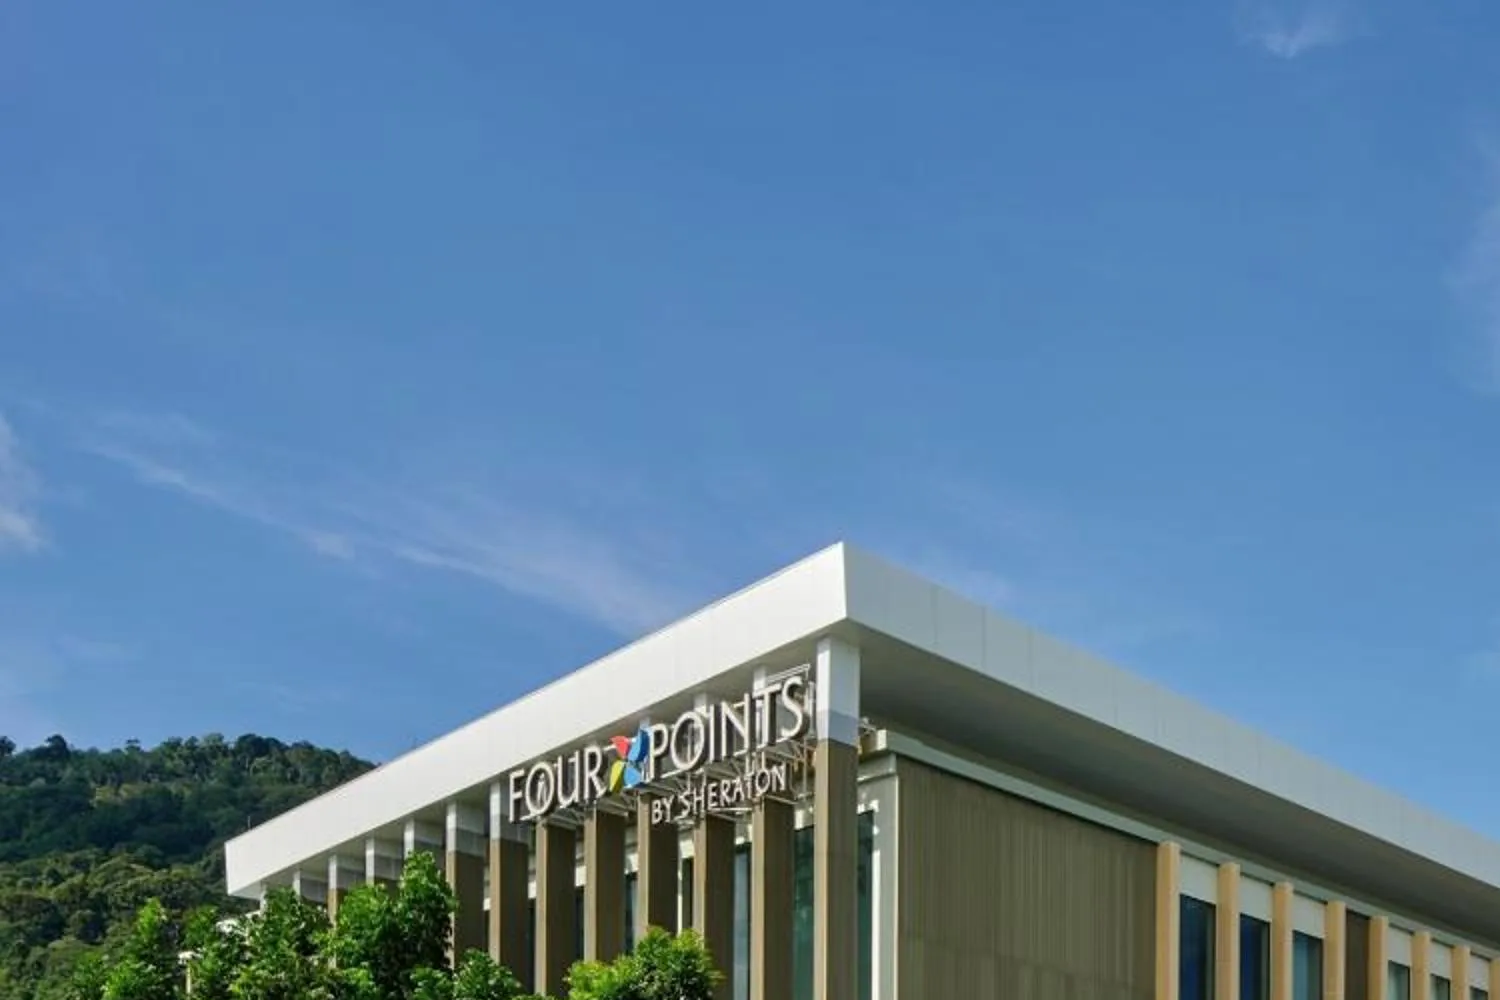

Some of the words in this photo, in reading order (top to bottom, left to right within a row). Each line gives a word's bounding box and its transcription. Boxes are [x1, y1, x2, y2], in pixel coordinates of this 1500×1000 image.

[509, 746, 609, 822] FOUR
[648, 675, 806, 780] POINTS
[652, 797, 675, 825] BY
[681, 764, 787, 818] SHERATON
